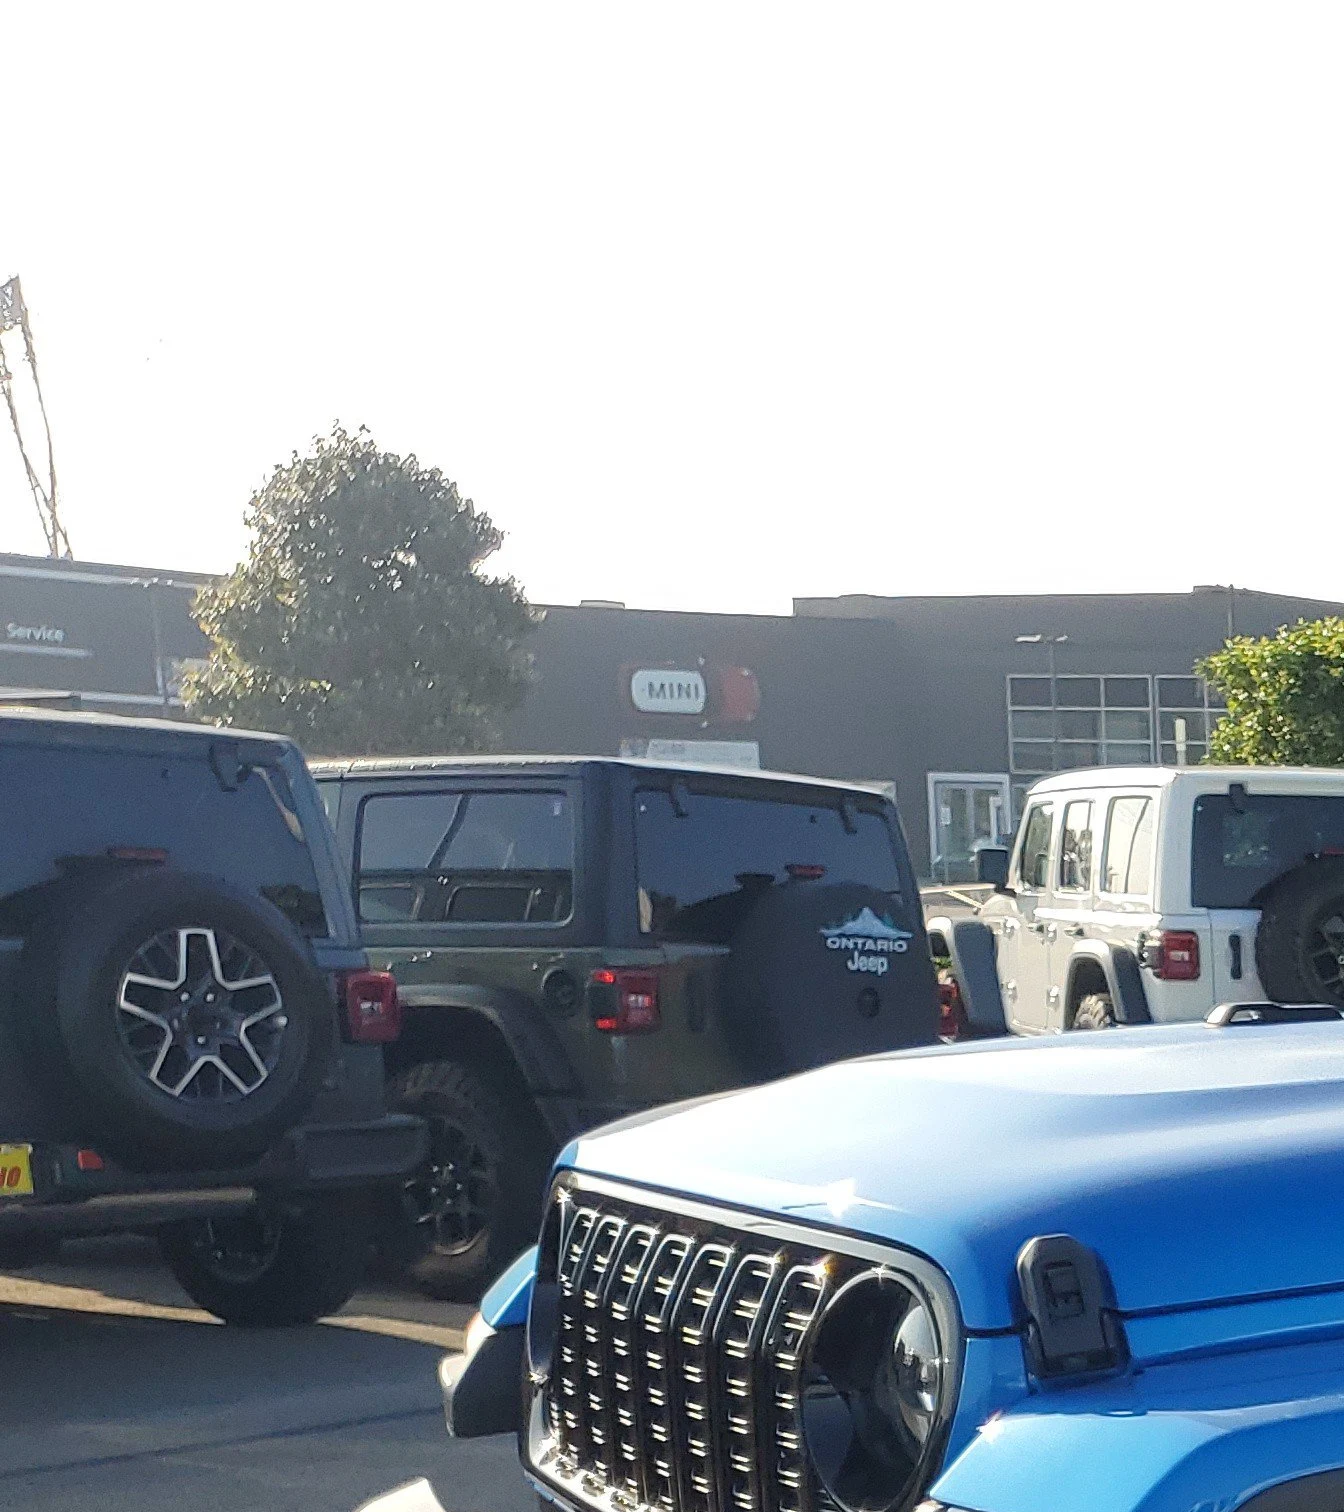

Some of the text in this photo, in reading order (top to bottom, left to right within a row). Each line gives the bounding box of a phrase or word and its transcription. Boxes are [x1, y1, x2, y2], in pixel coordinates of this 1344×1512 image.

[648, 681, 699, 700] MINI
[825, 937, 909, 953] ONTARIO
[846, 950, 889, 977] Jeep
